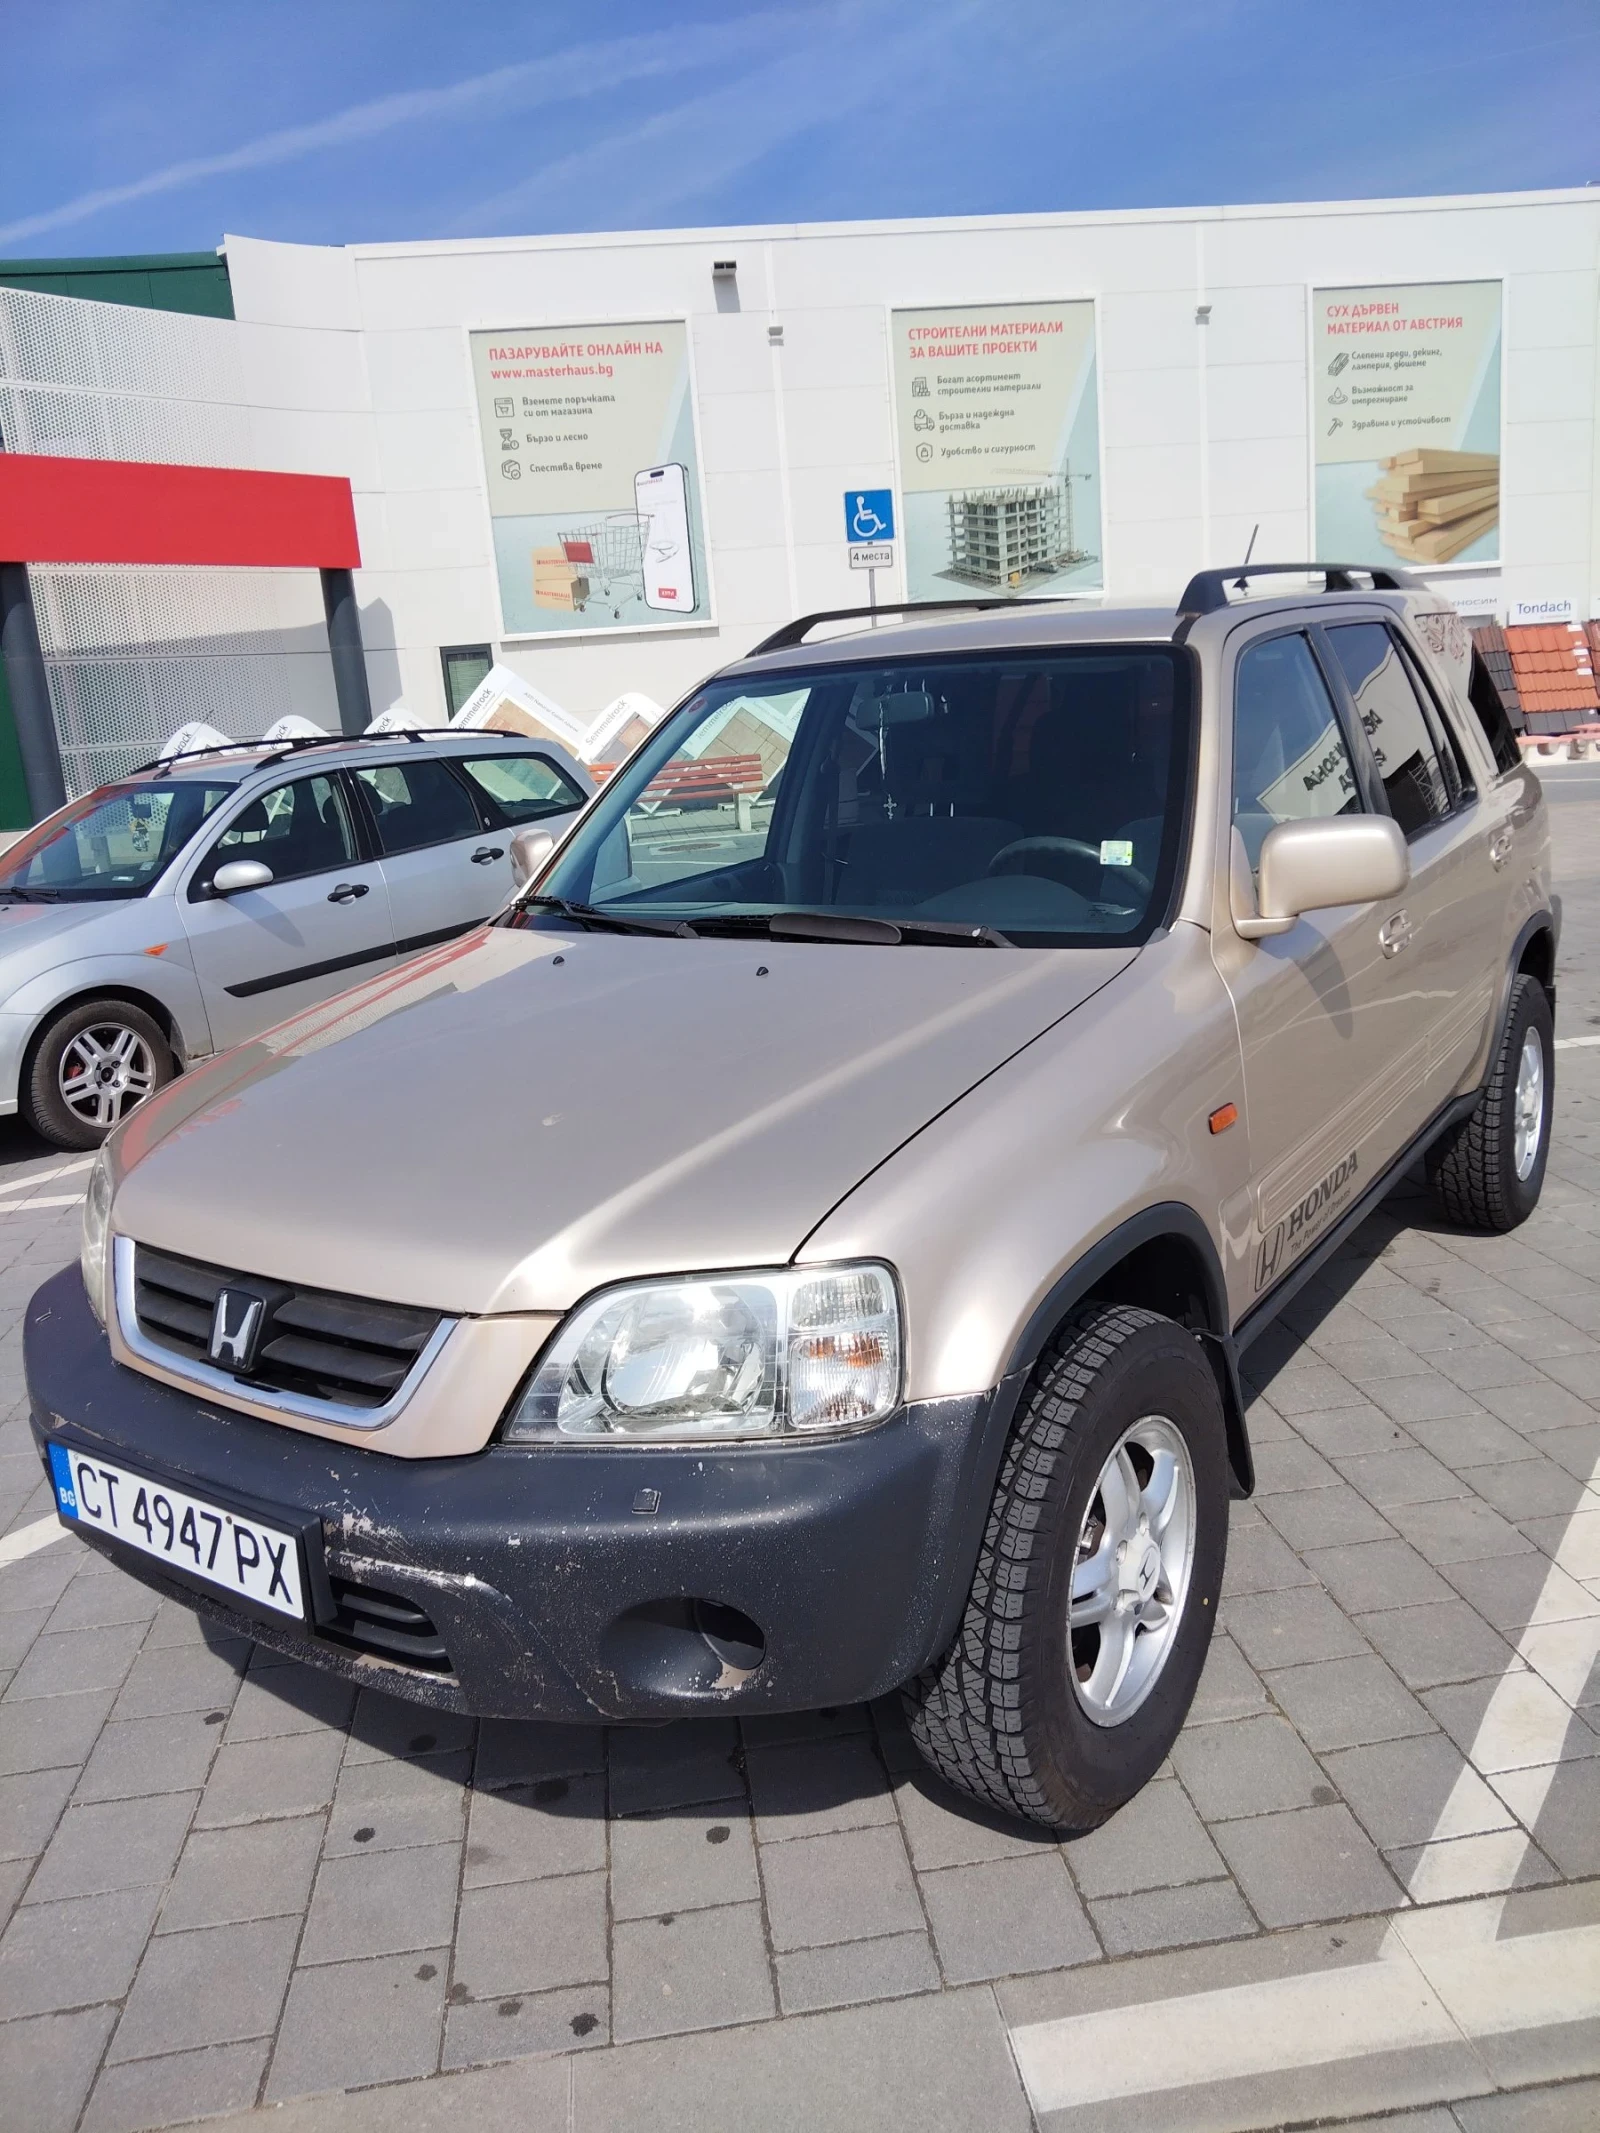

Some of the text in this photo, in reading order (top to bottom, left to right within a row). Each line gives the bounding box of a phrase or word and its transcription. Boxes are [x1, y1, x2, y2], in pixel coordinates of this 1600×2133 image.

[1327, 303, 1399, 317] СУХ ДЪРВЕН
[908, 321, 1063, 340] СТРОИТЕЛНИ МАТЕРИАЛИ
[1327, 317, 1463, 334] МАТЕРИАЛ ОТ АВСТРИЯ
[489, 341, 663, 360] ПАЗАРУВАЙТЕ ОНЛАЙН НА
[910, 340, 1037, 359] ЗА ВАШИТЕ ПРОЕКТИ
[491, 363, 613, 379] www.masterhaus.bg
[937, 373, 1021, 385] Богат асортимент
[937, 383, 1041, 397] строителни материали
[522, 394, 615, 406] Вземете поръчката
[536, 409, 549, 417] от
[551, 407, 593, 416] магазина
[939, 411, 964, 422] Бърза
[973, 409, 1015, 420] надеждна
[939, 422, 981, 433] доставка
[526, 433, 553, 444] Бързо
[563, 433, 588, 441] лесно
[941, 446, 982, 458] Удобство
[991, 444, 1036, 456] сигурност
[530, 461, 602, 473] Спестява време
[853, 552, 890, 561] 4 места
[1517, 600, 1571, 615] Tondach
[459, 688, 492, 730] emmelrock
[585, 699, 628, 746] Semmelrock
[1287, 1150, 1359, 1241] HONDA
[59, 1487, 76, 1508] BG
[77, 1462, 293, 1605] CT 4947 PX
